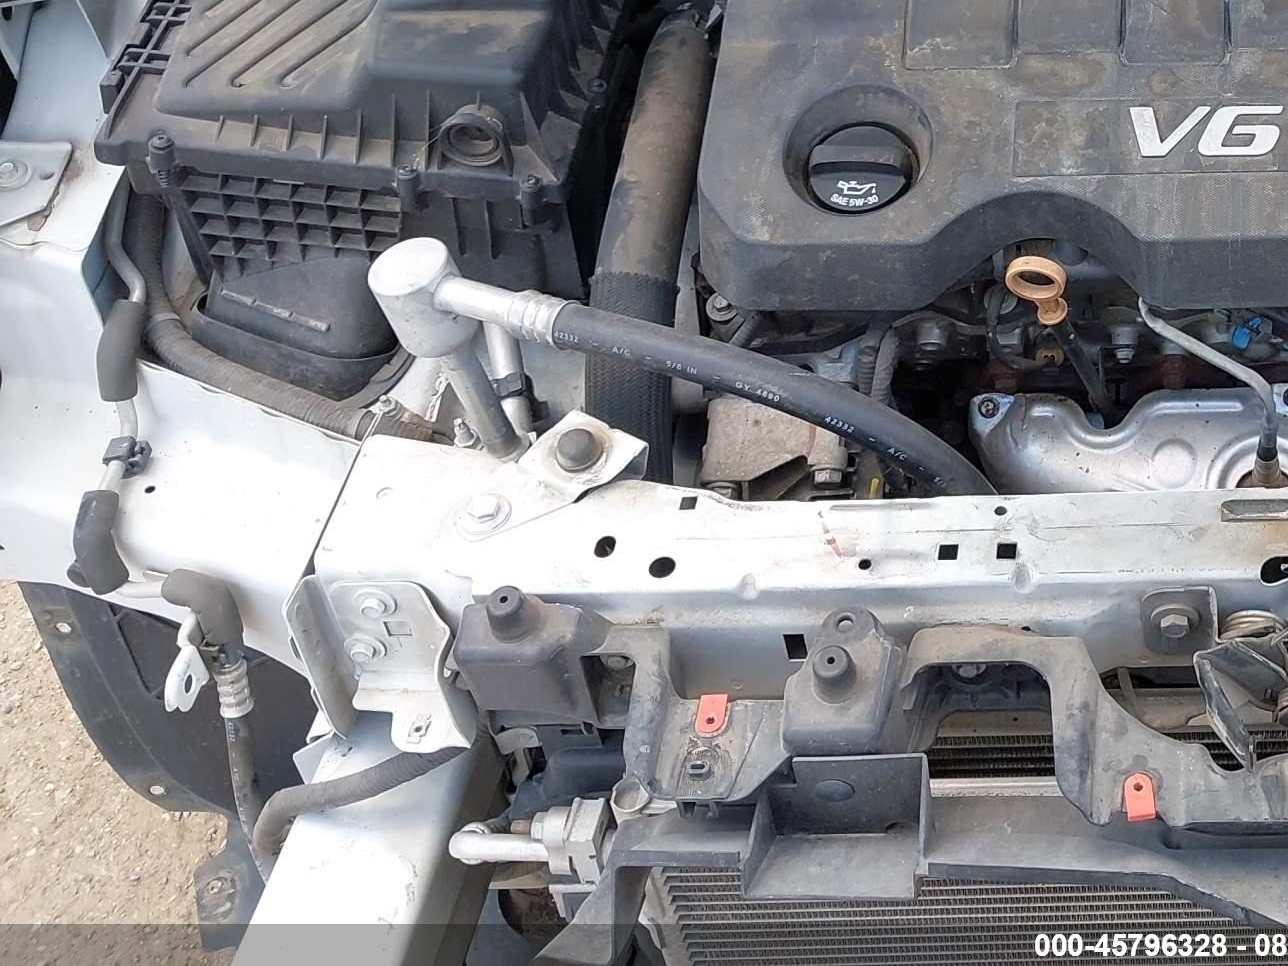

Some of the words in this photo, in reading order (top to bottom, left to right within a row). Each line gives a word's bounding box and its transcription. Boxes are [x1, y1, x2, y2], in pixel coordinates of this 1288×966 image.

[1129, 105, 1284, 157] V6
[831, 194, 849, 205] SAE
[849, 195, 879, 206] 5W-30
[612, 345, 631, 356] A/C
[687, 365, 698, 375] IN
[824, 416, 855, 433] 42332
[887, 447, 907, 461] A/C
